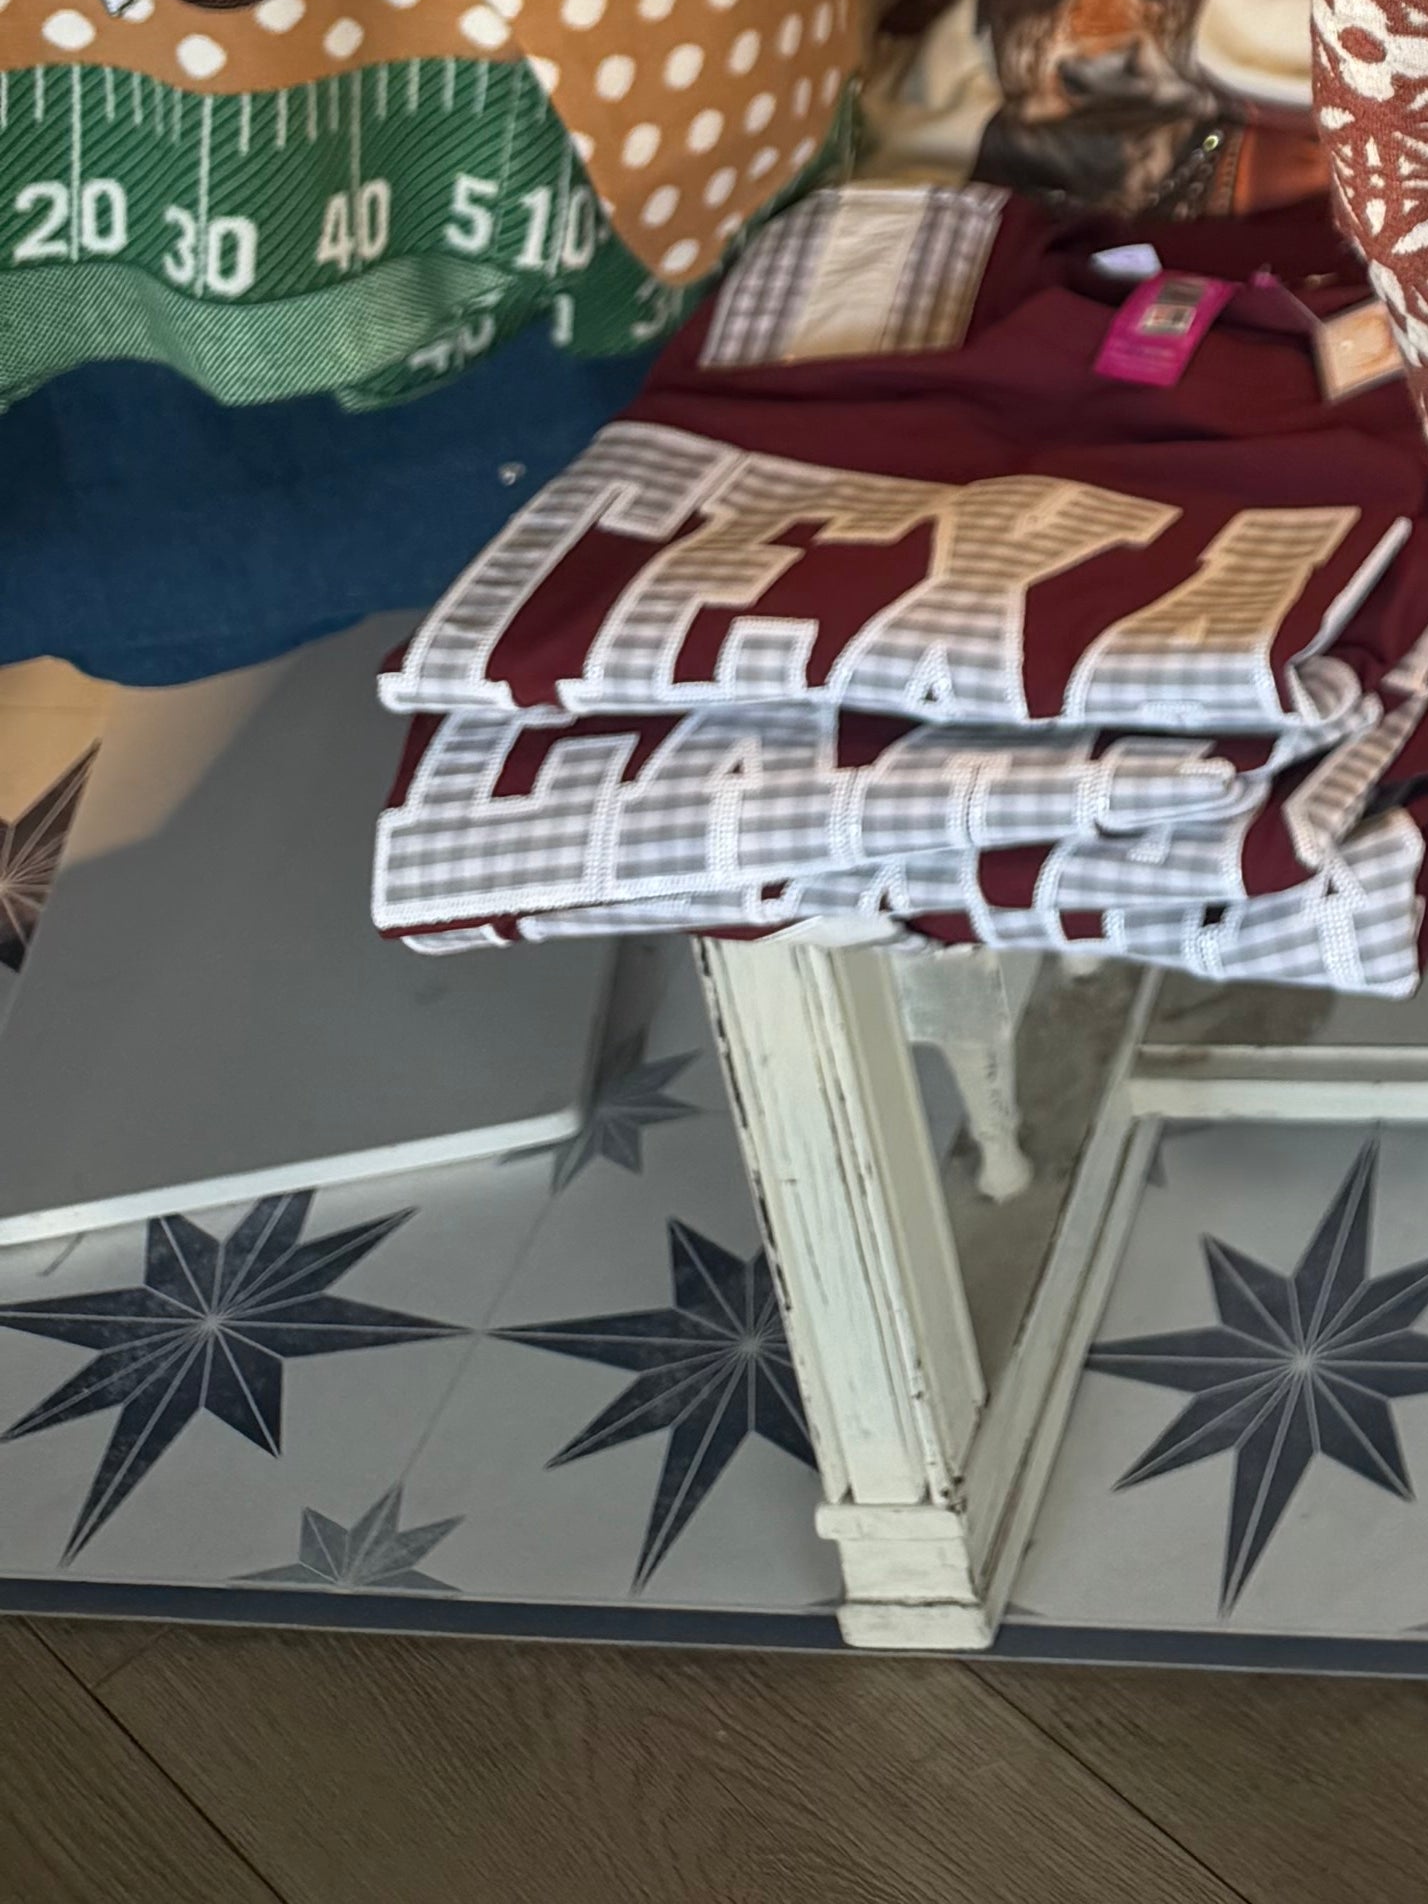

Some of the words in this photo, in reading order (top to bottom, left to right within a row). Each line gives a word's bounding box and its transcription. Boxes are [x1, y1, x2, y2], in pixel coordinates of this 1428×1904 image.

[13, 176, 129, 262] 20
[161, 202, 258, 298] 30
[315, 176, 392, 273] 40
[443, 172, 500, 255] 5
